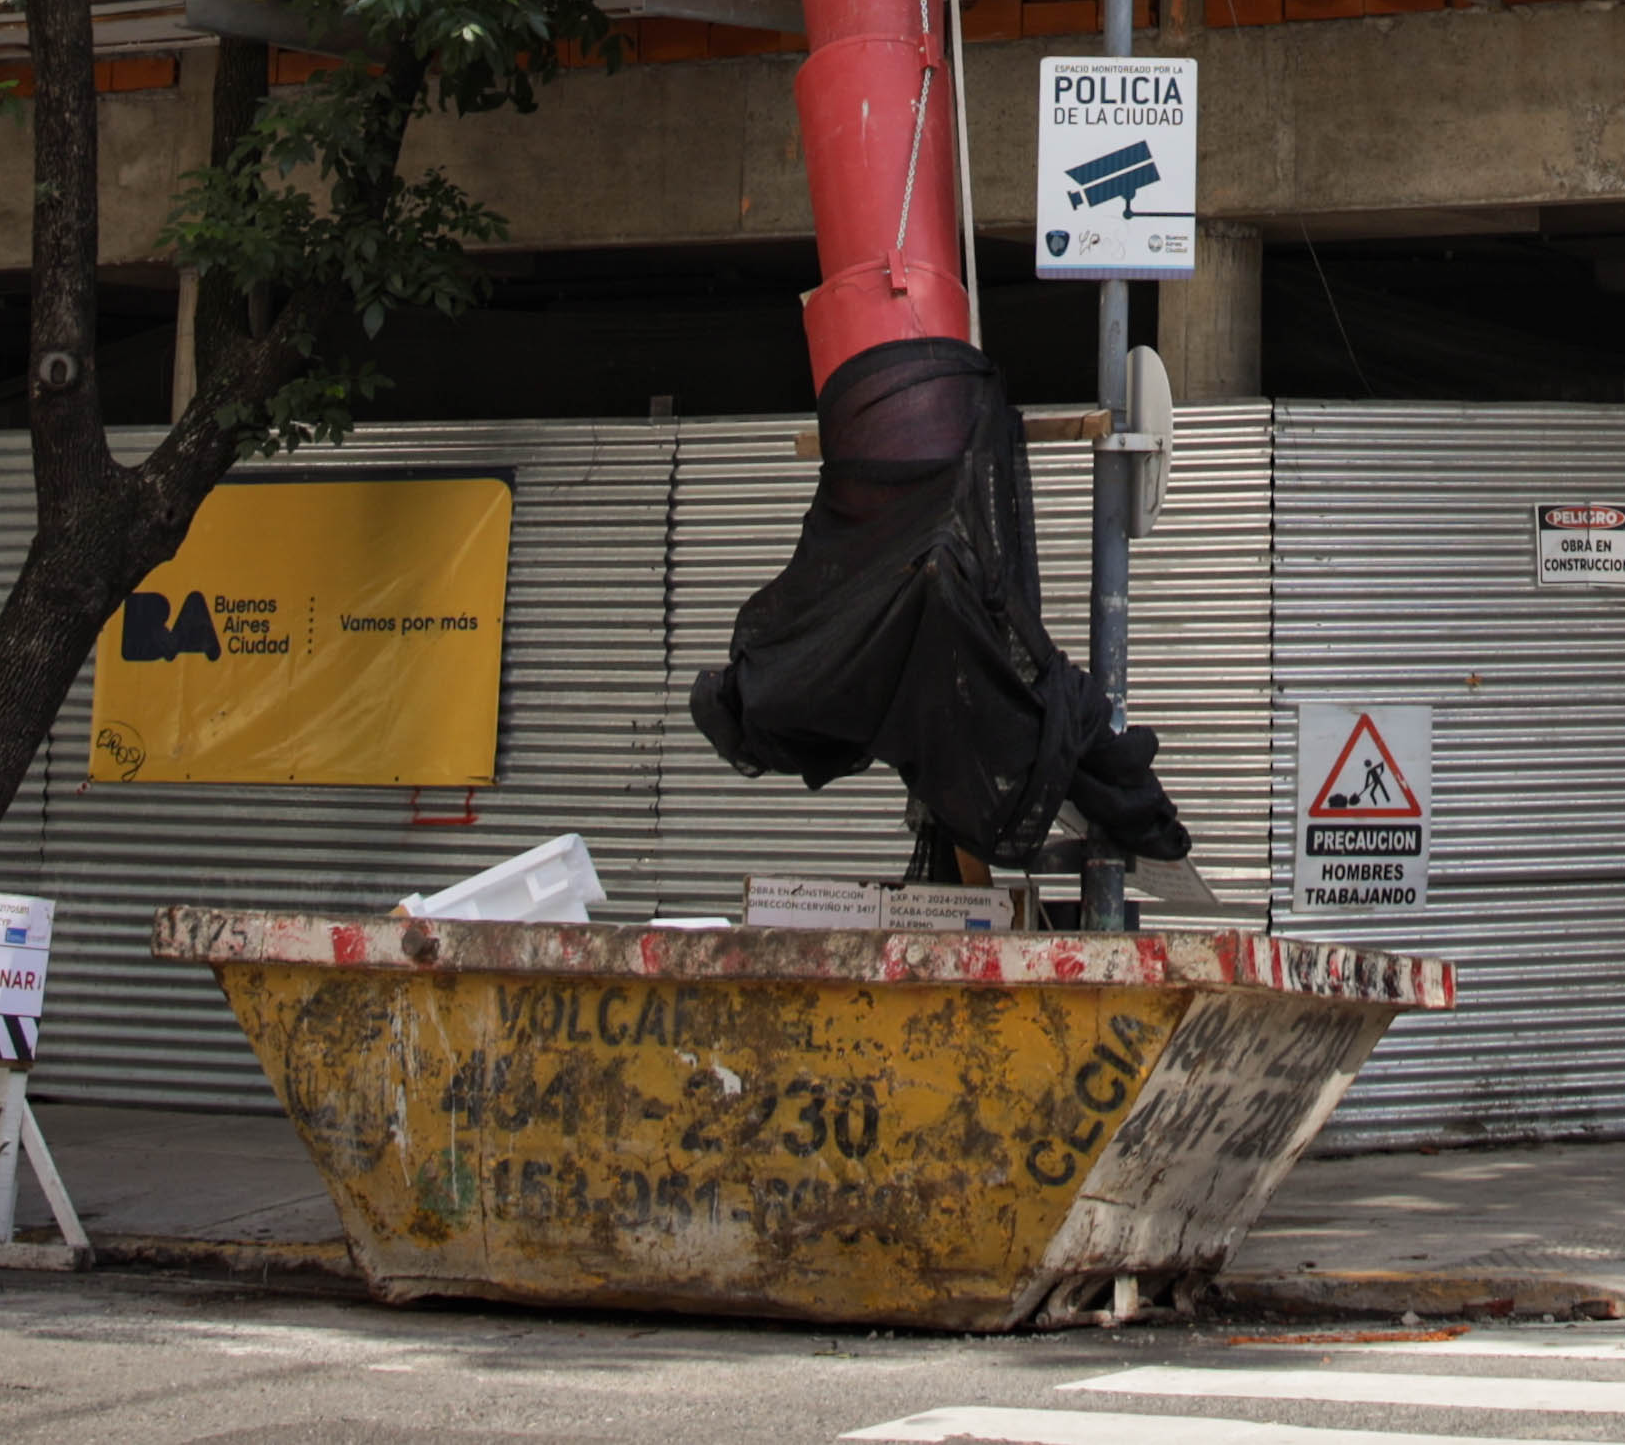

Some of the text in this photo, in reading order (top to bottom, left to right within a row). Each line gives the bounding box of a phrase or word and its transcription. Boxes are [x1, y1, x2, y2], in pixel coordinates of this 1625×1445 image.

[1055, 65, 1183, 74] ESPACIO MONITOREADO POR LA
[1055, 76, 1183, 105] POLICIA
[1054, 108, 1183, 125] DE LA CIUDAD
[1553, 511, 1617, 524] PELIGRO
[1562, 540, 1611, 552] OBRA EN
[214, 596, 277, 614] Buenos
[121, 591, 221, 662] BA
[224, 617, 270, 634] Aires
[341, 612, 478, 635] Vamos por más
[228, 636, 289, 654] Ciudad
[1314, 831, 1416, 851] PRECAUCION
[1322, 864, 1404, 881] HOMBRES
[750, 886, 864, 900] OBRA EN CONSTRUCCION
[1305, 887, 1416, 905] TRABAJANDO
[857, 904, 876, 914] 3417
[890, 907, 970, 919] GCABA-DGADCYP
